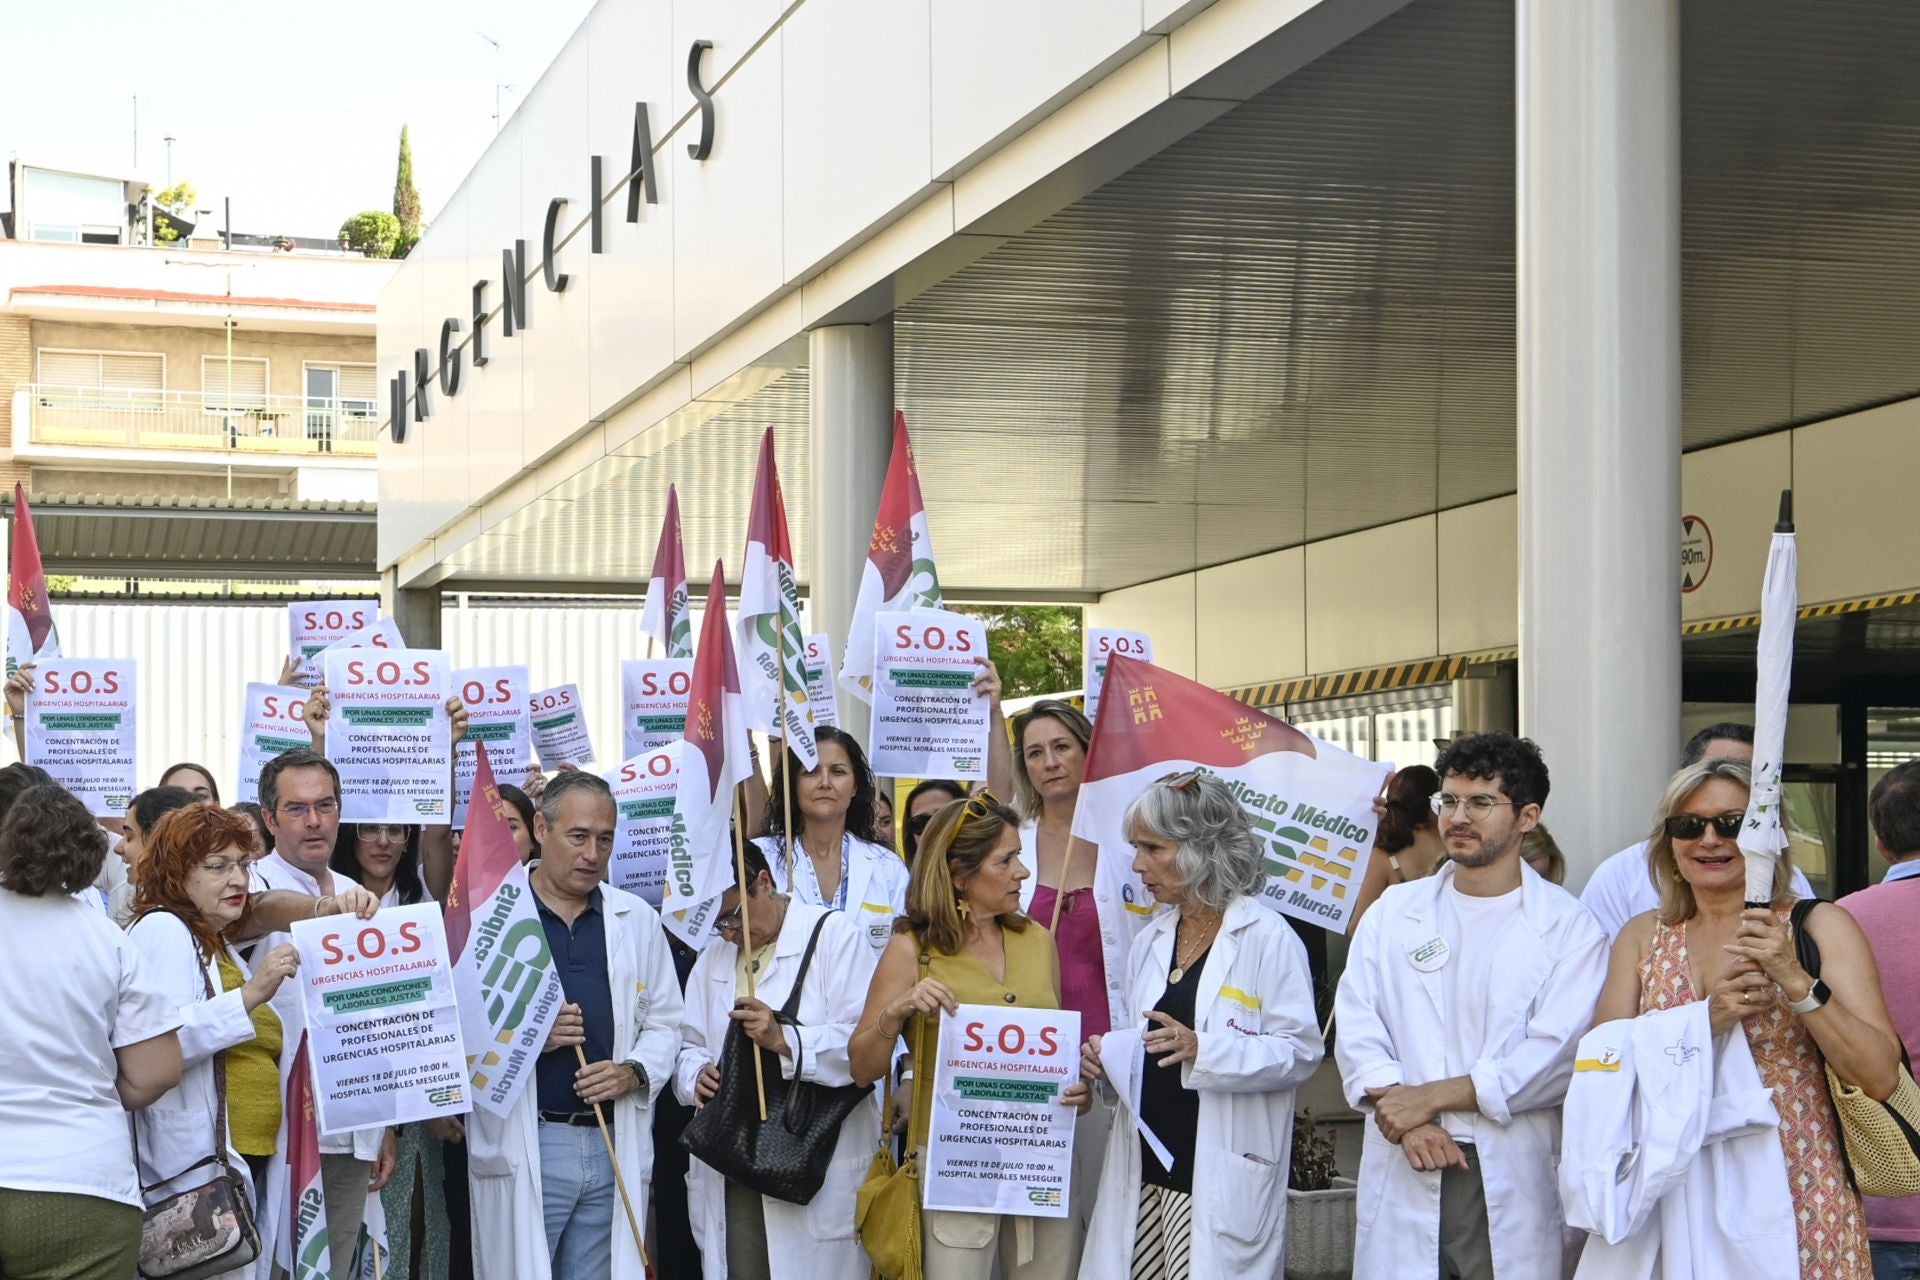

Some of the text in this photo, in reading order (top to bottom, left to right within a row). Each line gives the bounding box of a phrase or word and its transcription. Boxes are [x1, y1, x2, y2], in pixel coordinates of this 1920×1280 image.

[390, 39, 715, 444] URGENCIAS
[305, 611, 364, 630] S.O.S
[896, 625, 971, 651] S.O.S
[44, 671, 118, 694] S.O.S
[347, 661, 430, 685] S.O.S
[530, 691, 570, 712] S.O.S
[894, 696, 960, 704] CONCENTRACIÓN
[896, 706, 957, 714] PROFESIONALES
[468, 709, 521, 718] HOSPITALARIAS
[251, 723, 287, 732] URGENCIAS
[45, 737, 108, 745] CONCENTRACIÓN
[349, 734, 419, 742] CONCENTRACIÓN
[630, 808, 670, 817] LABORALES
[1291, 803, 1368, 843] Médico
[617, 850, 660, 860] URGENCIAS
[671, 813, 694, 896] Médico
[1265, 884, 1342, 920] de Murcia
[322, 921, 421, 965] S.O.S
[312, 959, 437, 986] URGENCIAS HOSPITALARIAS
[327, 981, 429, 1002] POR UNAS CONDICIONES
[336, 991, 421, 1011] LABORALES JUSTAS
[336, 1010, 435, 1034] CONCENTRACIÓN DE
[341, 1024, 433, 1047] PROFESIONALES DE
[964, 1022, 1058, 1056] S.O.S
[323, 1034, 456, 1064] URGENCIAS HOSPITALARIAS
[336, 1062, 450, 1087] VIERNES 18 DE JULIO 10:00 H.
[947, 1060, 1068, 1075] URGENCIAS HOSPITALARIAS
[330, 1072, 460, 1100] HOSPITAL MORALES MESEGUER
[957, 1080, 974, 1088] POR
[1000, 1083, 1055, 1093] CONDICIONES
[964, 1089, 1046, 1100] LABORALES JUSTAS
[958, 1109, 1053, 1122] CONCENTRACIÓN DE
[960, 1123, 1048, 1134] PROFESIONALES DE
[940, 1135, 1066, 1148] URGENCIAS HOSPITALARIAS
[947, 1160, 978, 1168] VIERNES
[991, 1161, 1000, 1169] DE
[1001, 1162, 1023, 1171] JULIO
[1026, 1163, 1045, 1171] 10:00
[1048, 1164, 1055, 1172] H.
[938, 1170, 1062, 1183] HOSPITAL MORALES MESEGUER
